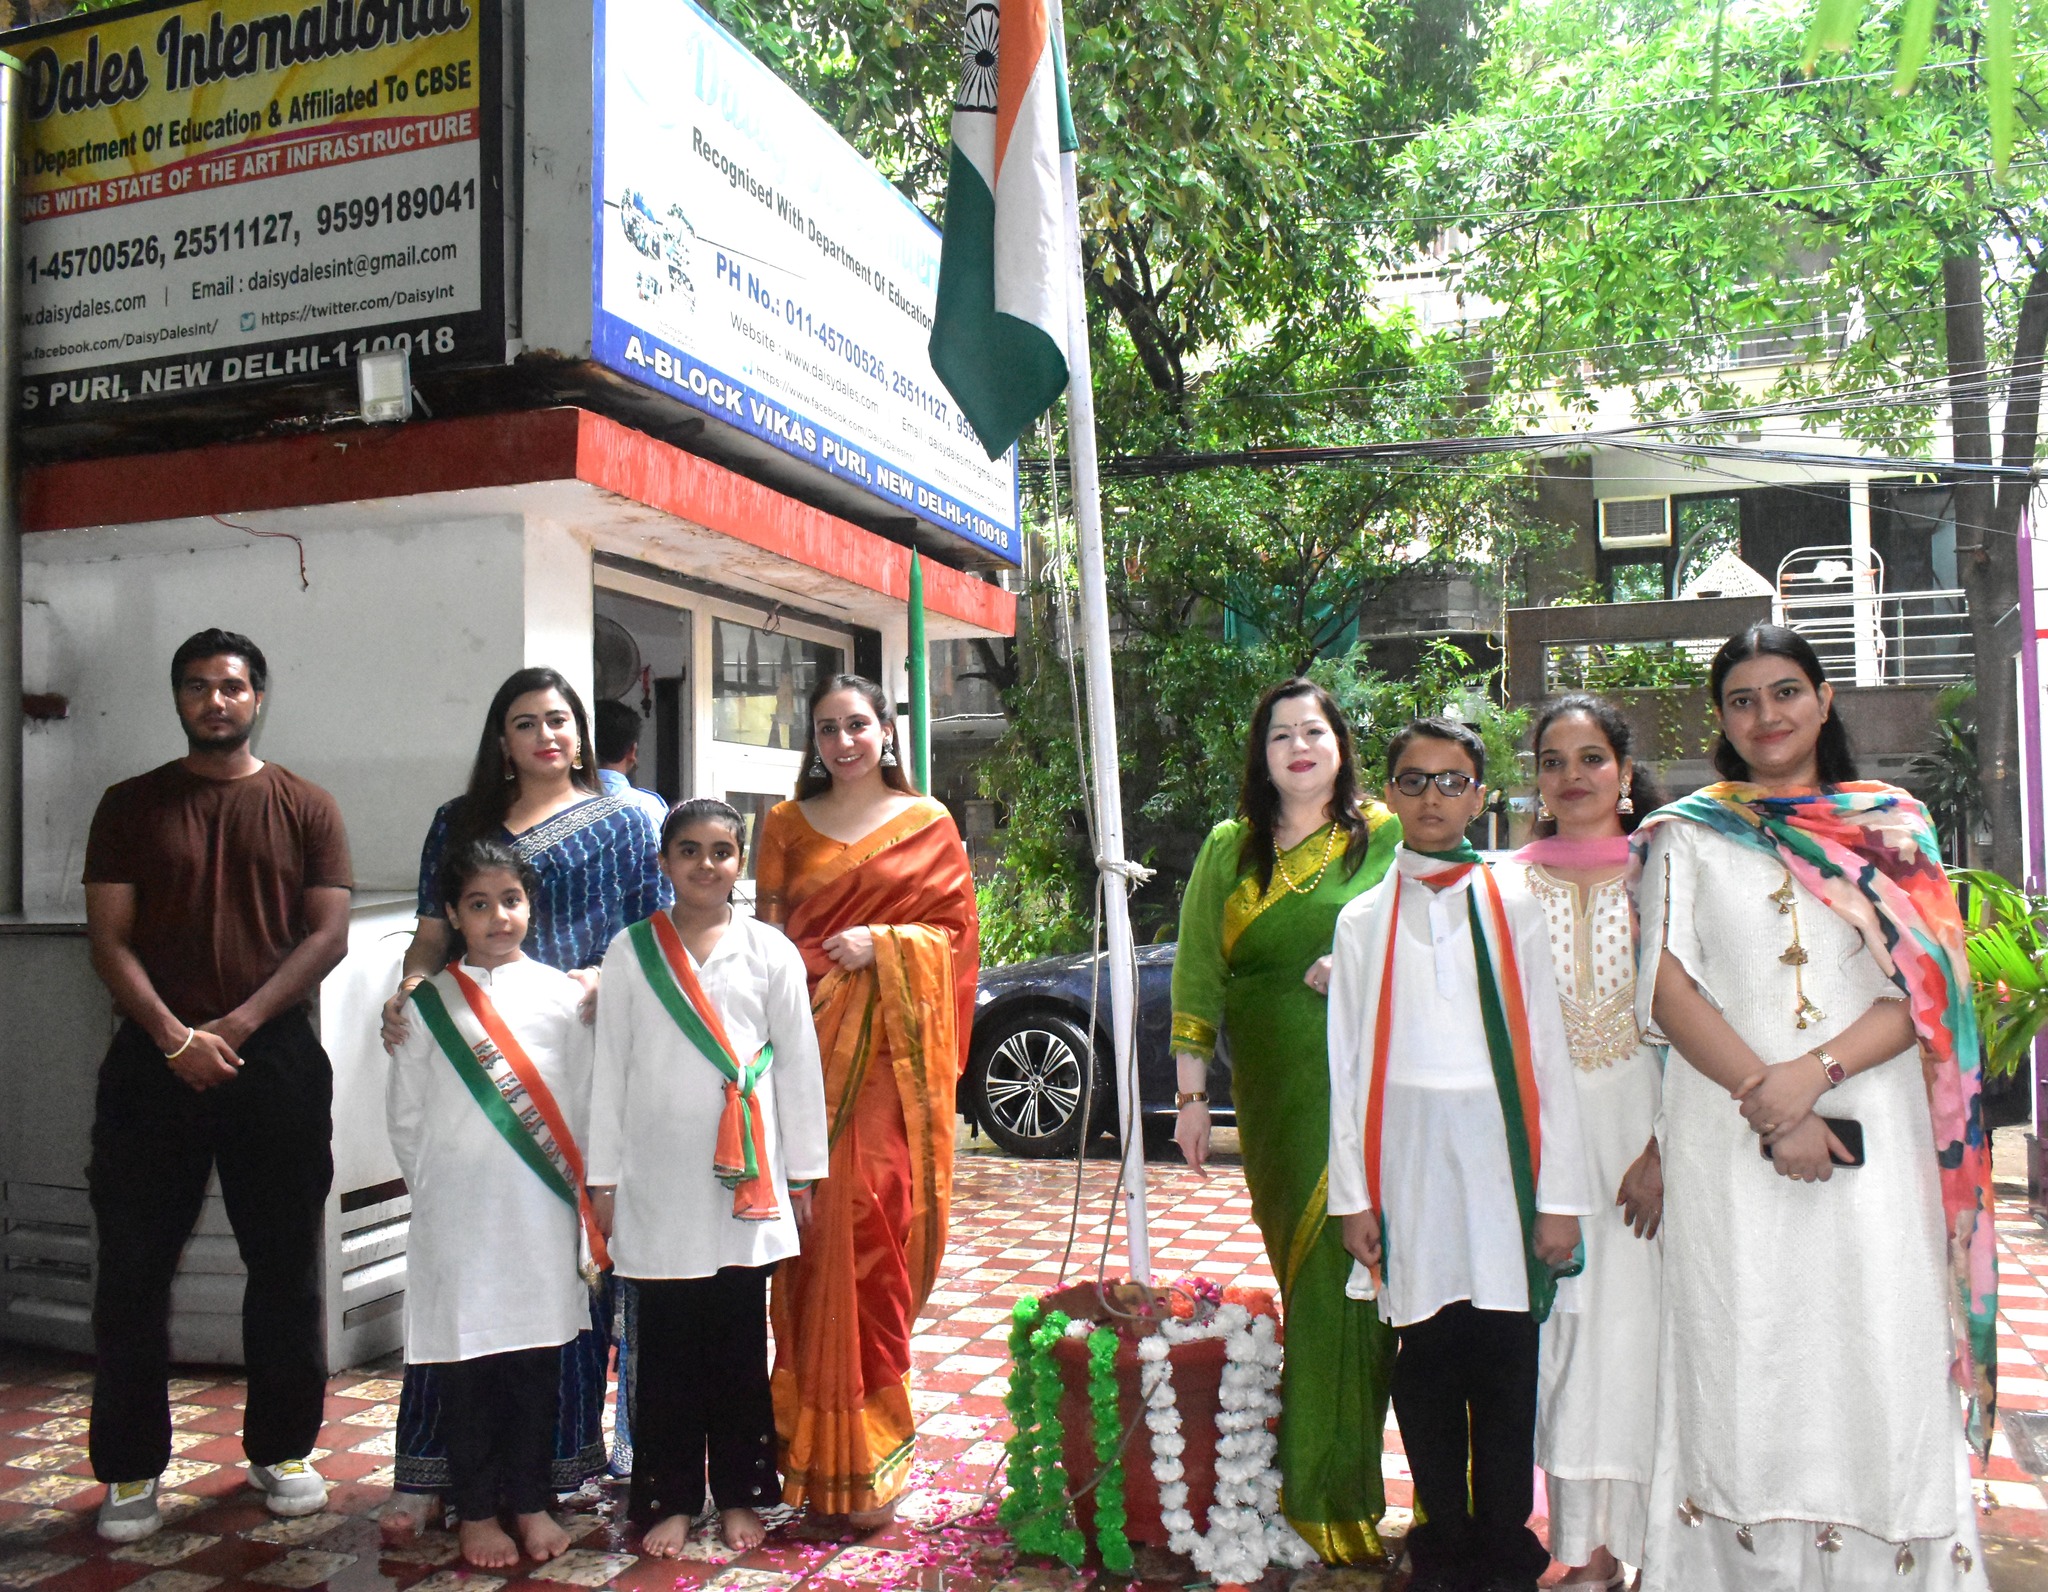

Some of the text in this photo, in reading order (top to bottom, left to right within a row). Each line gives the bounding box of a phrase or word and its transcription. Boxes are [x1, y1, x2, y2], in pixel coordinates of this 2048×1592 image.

[24, 34, 149, 121] Dales
[34, 131, 137, 177] Department
[142, 123, 163, 152] Of
[169, 108, 261, 147] Education
[268, 98, 282, 128] &
[289, 79, 378, 124] Affiliated
[384, 75, 409, 104] To
[415, 59, 472, 98] CBSE
[55, 184, 100, 211] WITH
[107, 172, 163, 203] STATE
[168, 166, 193, 191] OF
[198, 158, 236, 185] THE
[242, 151, 281, 177] ART
[287, 112, 472, 169] INFRASTRUCTURE
[174, 211, 300, 260] 25511127,
[317, 178, 475, 236] 9599189041
[693, 126, 773, 210] Recognised
[777, 192, 804, 234] With
[808, 217, 872, 287] Department
[874, 270, 886, 296] Of
[889, 281, 934, 333] Education
[192, 275, 234, 300] Email
[248, 243, 457, 290] daisydalesint@gmail.com
[261, 285, 455, 326] https://twitter.com/DaisyInt
[49, 374, 129, 407] PURI,
[140, 361, 213, 394] NEW
[222, 326, 455, 382] DELHI-110018
[716, 251, 741, 292] PH
[748, 272, 780, 317] No.:
[786, 299, 889, 391] 011-45700526,
[893, 370, 951, 431] 25511127,
[731, 311, 776, 353] Website
[785, 349, 879, 415] www.daisydales.com
[902, 417, 923, 440] Email
[624, 335, 1009, 549] A-BLOCK VIKAS PURI, NEW DELHI-110018
